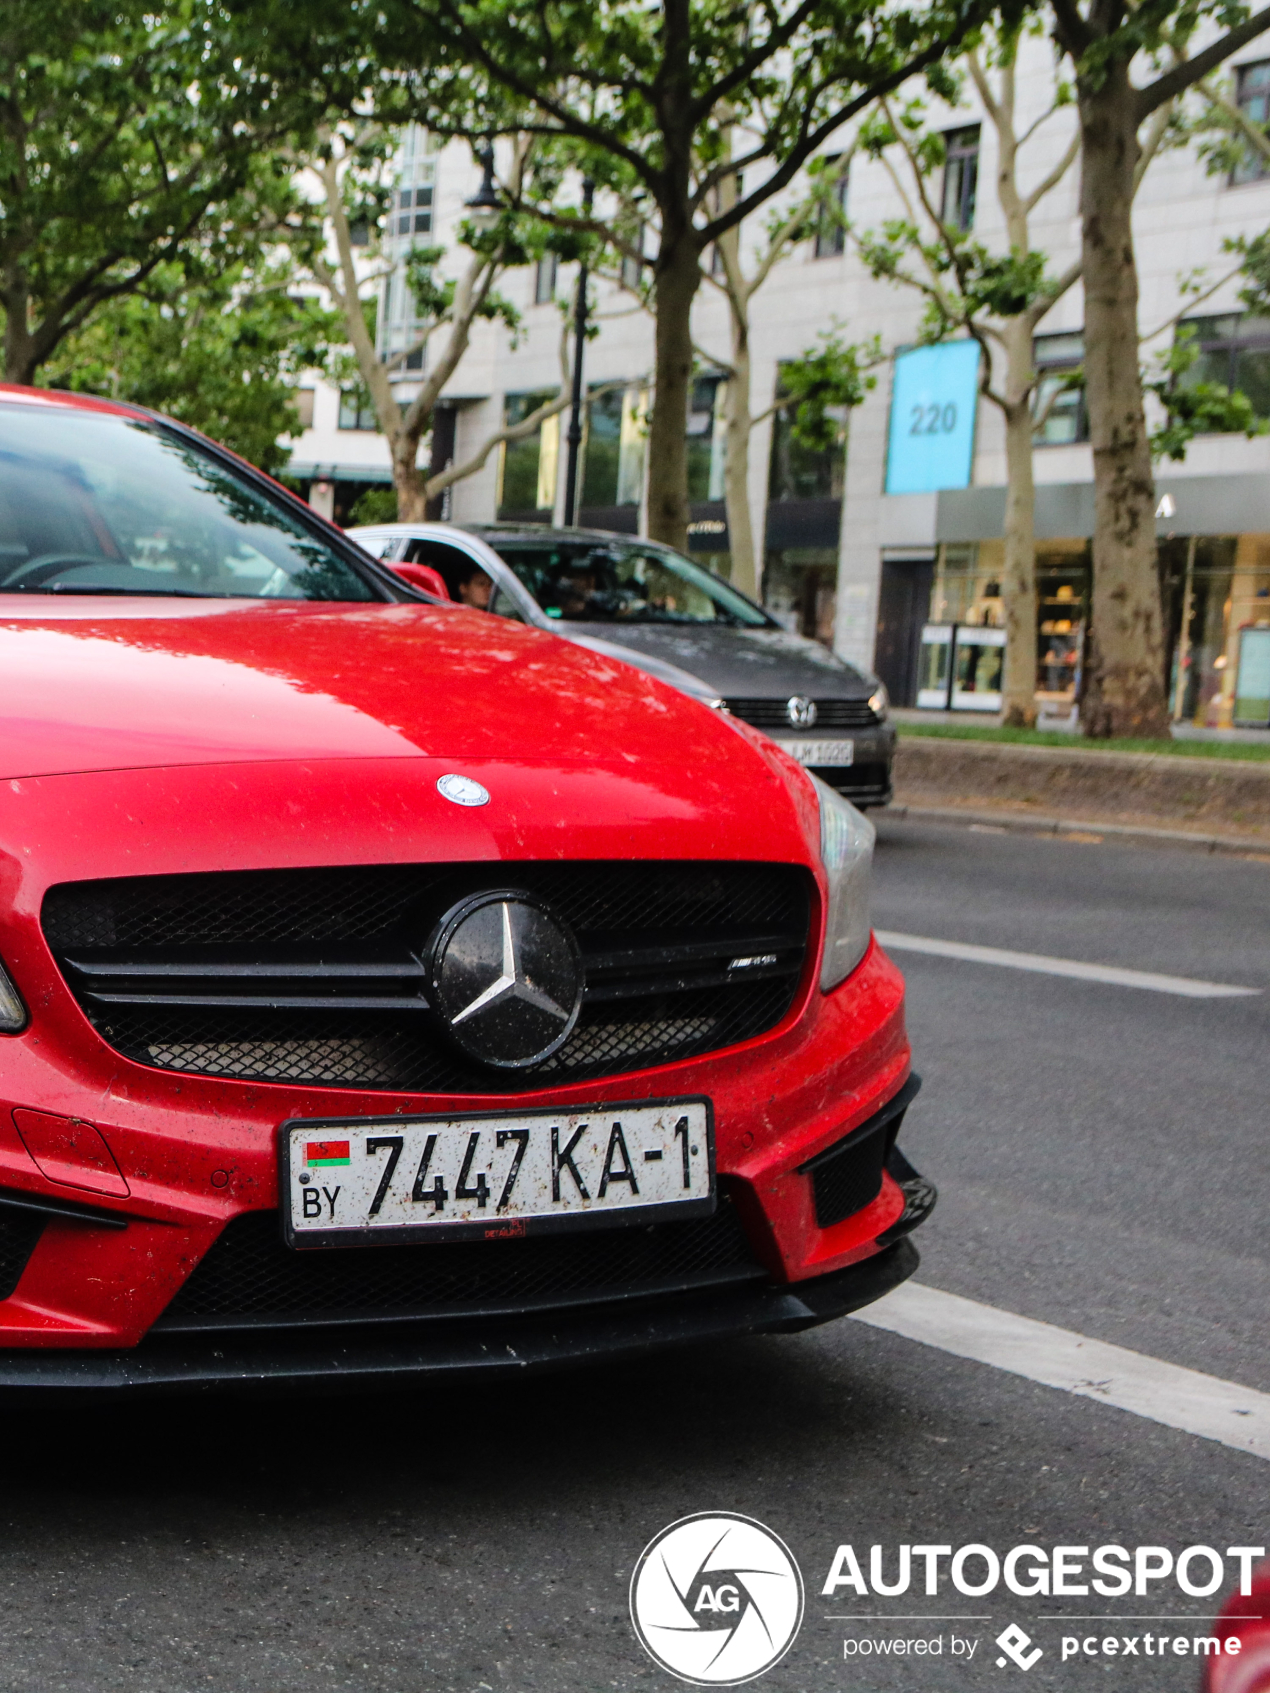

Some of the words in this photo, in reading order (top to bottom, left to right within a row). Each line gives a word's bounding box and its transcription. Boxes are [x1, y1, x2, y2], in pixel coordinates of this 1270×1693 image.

[909, 402, 957, 436] 220
[366, 1128, 530, 1215] 7447
[551, 1115, 691, 1202] KA-1
[302, 1186, 341, 1218] BY
